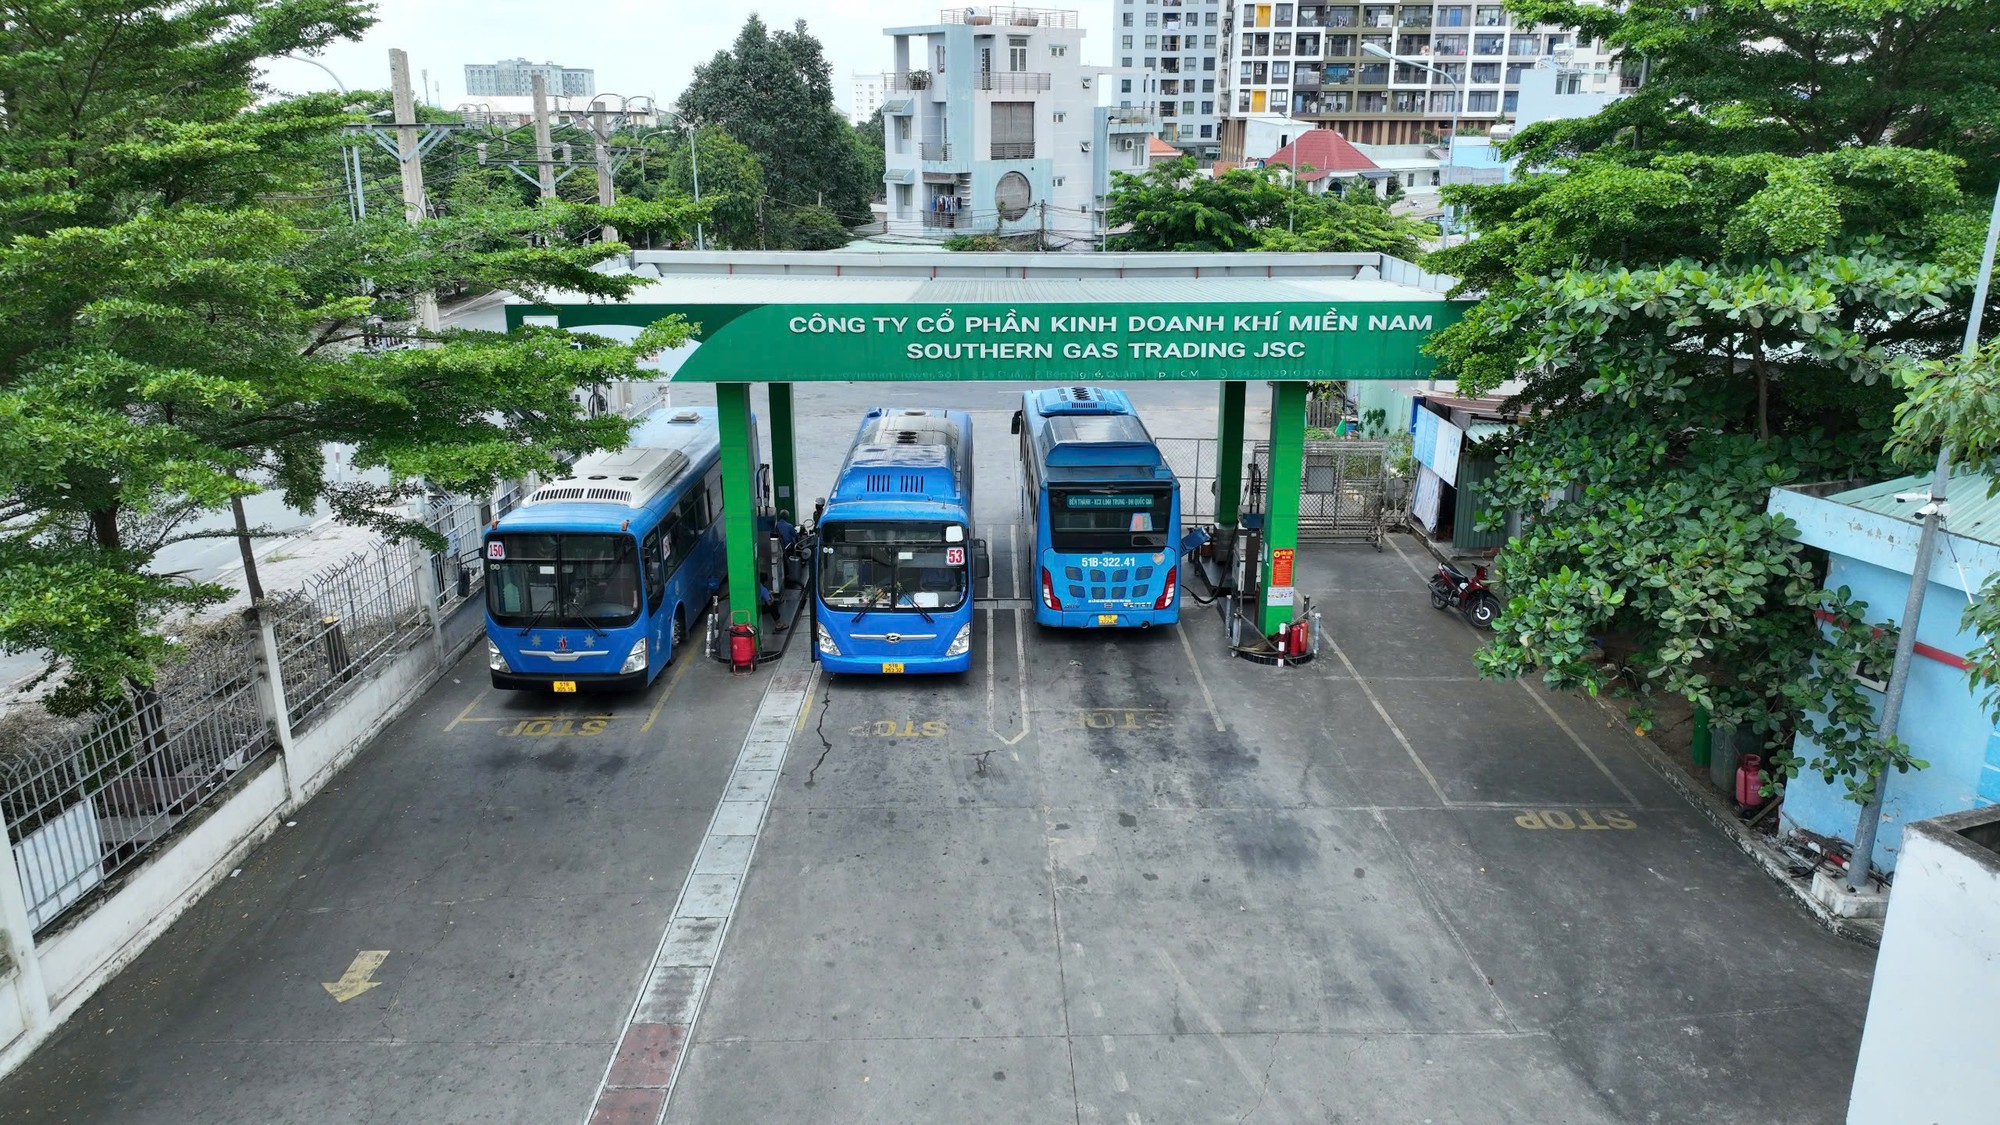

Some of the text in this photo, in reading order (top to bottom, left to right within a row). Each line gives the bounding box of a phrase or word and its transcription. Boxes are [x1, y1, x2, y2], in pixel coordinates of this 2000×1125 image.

[789, 307, 1433, 333] CÔNG TY CỔ PHẦN KINH DOANH KHÍ MIỀN NAM
[906, 342, 1306, 359] SOUTHERN GAS TRADING JSC
[489, 544, 503, 557] 150
[949, 550, 962, 563] 53
[1081, 557, 1136, 567] 51B-322.41
[1514, 808, 1638, 830] STOP
